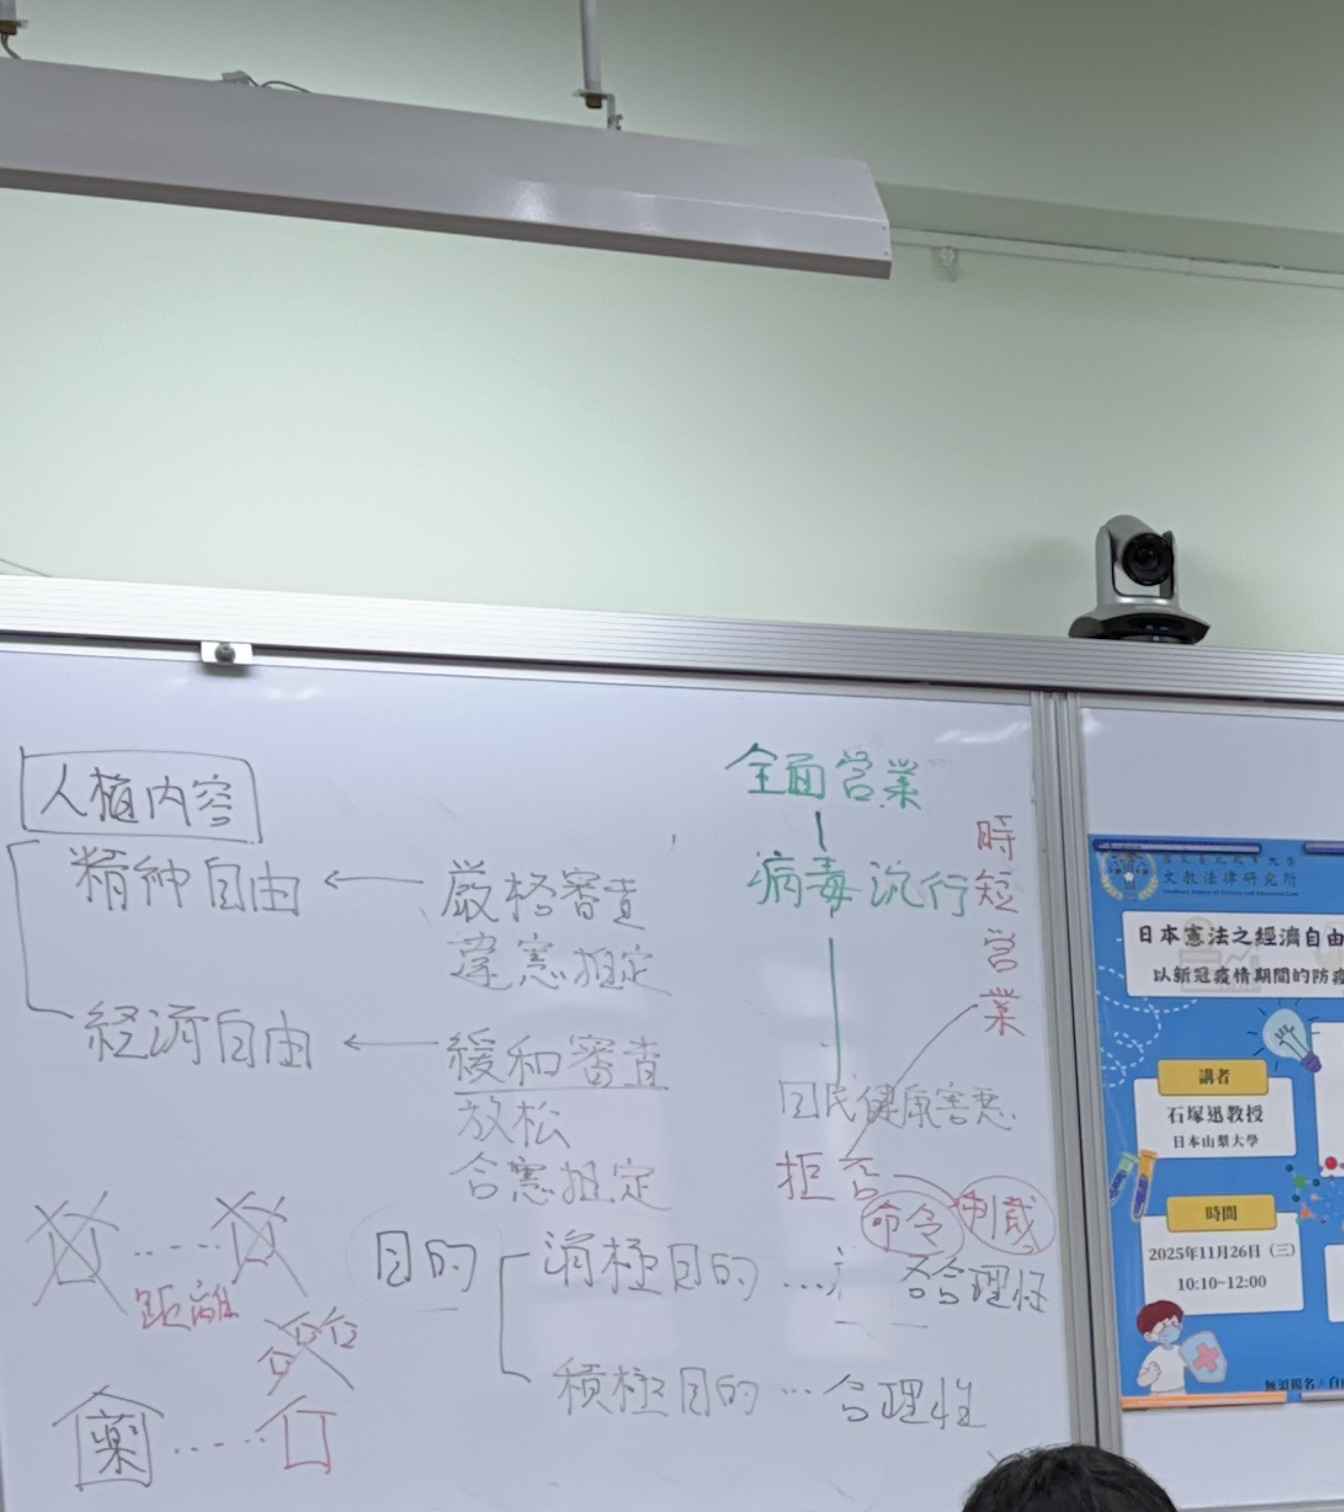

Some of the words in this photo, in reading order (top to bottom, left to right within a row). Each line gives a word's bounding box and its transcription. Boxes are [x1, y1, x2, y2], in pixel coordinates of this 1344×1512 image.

[1198, 1068, 1231, 1085] 講者
[1205, 1205, 1238, 1222] 時間
[1177, 1275, 1267, 1291] 10:10~12:00
